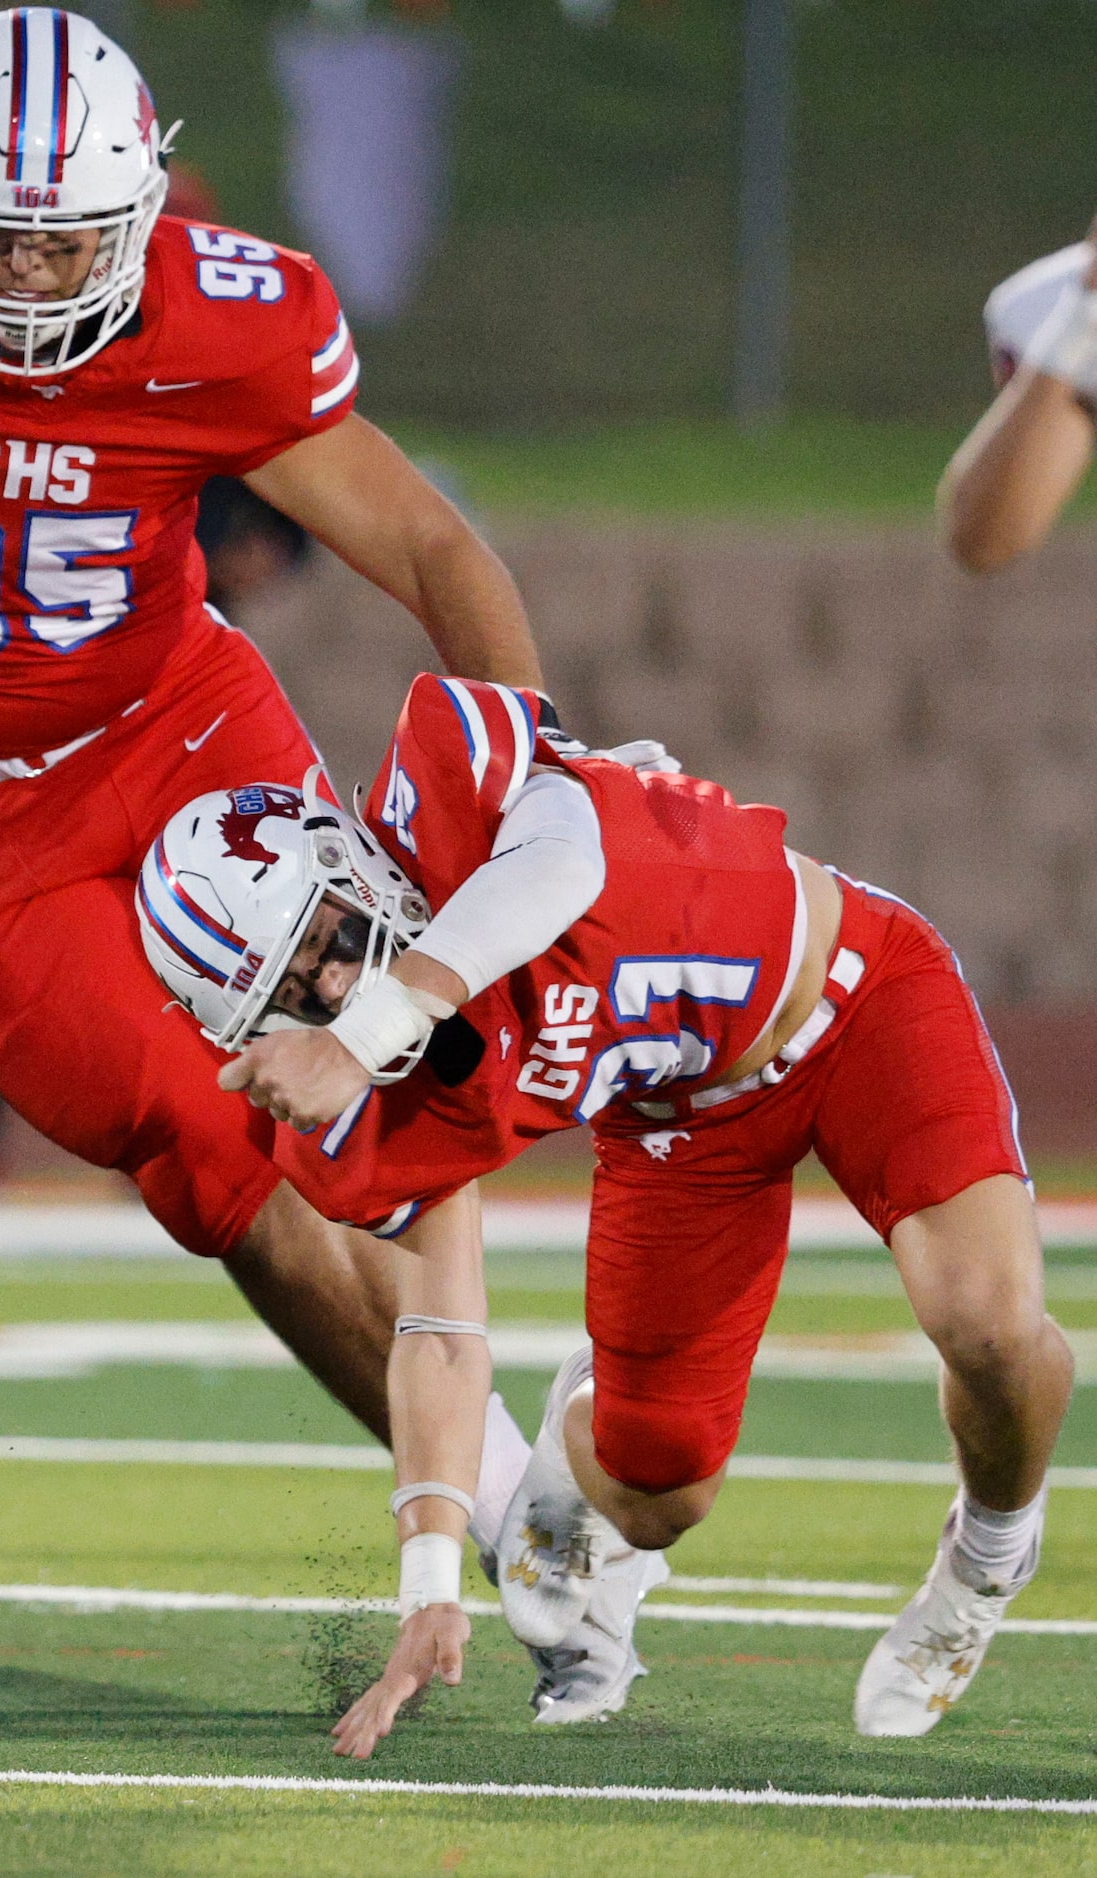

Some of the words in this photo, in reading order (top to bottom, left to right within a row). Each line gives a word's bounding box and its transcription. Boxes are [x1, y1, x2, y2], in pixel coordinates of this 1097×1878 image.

[13, 186, 59, 208] 104
[186, 226, 286, 305] 95
[229, 950, 265, 994] 104
[515, 983, 600, 1101] GHS
